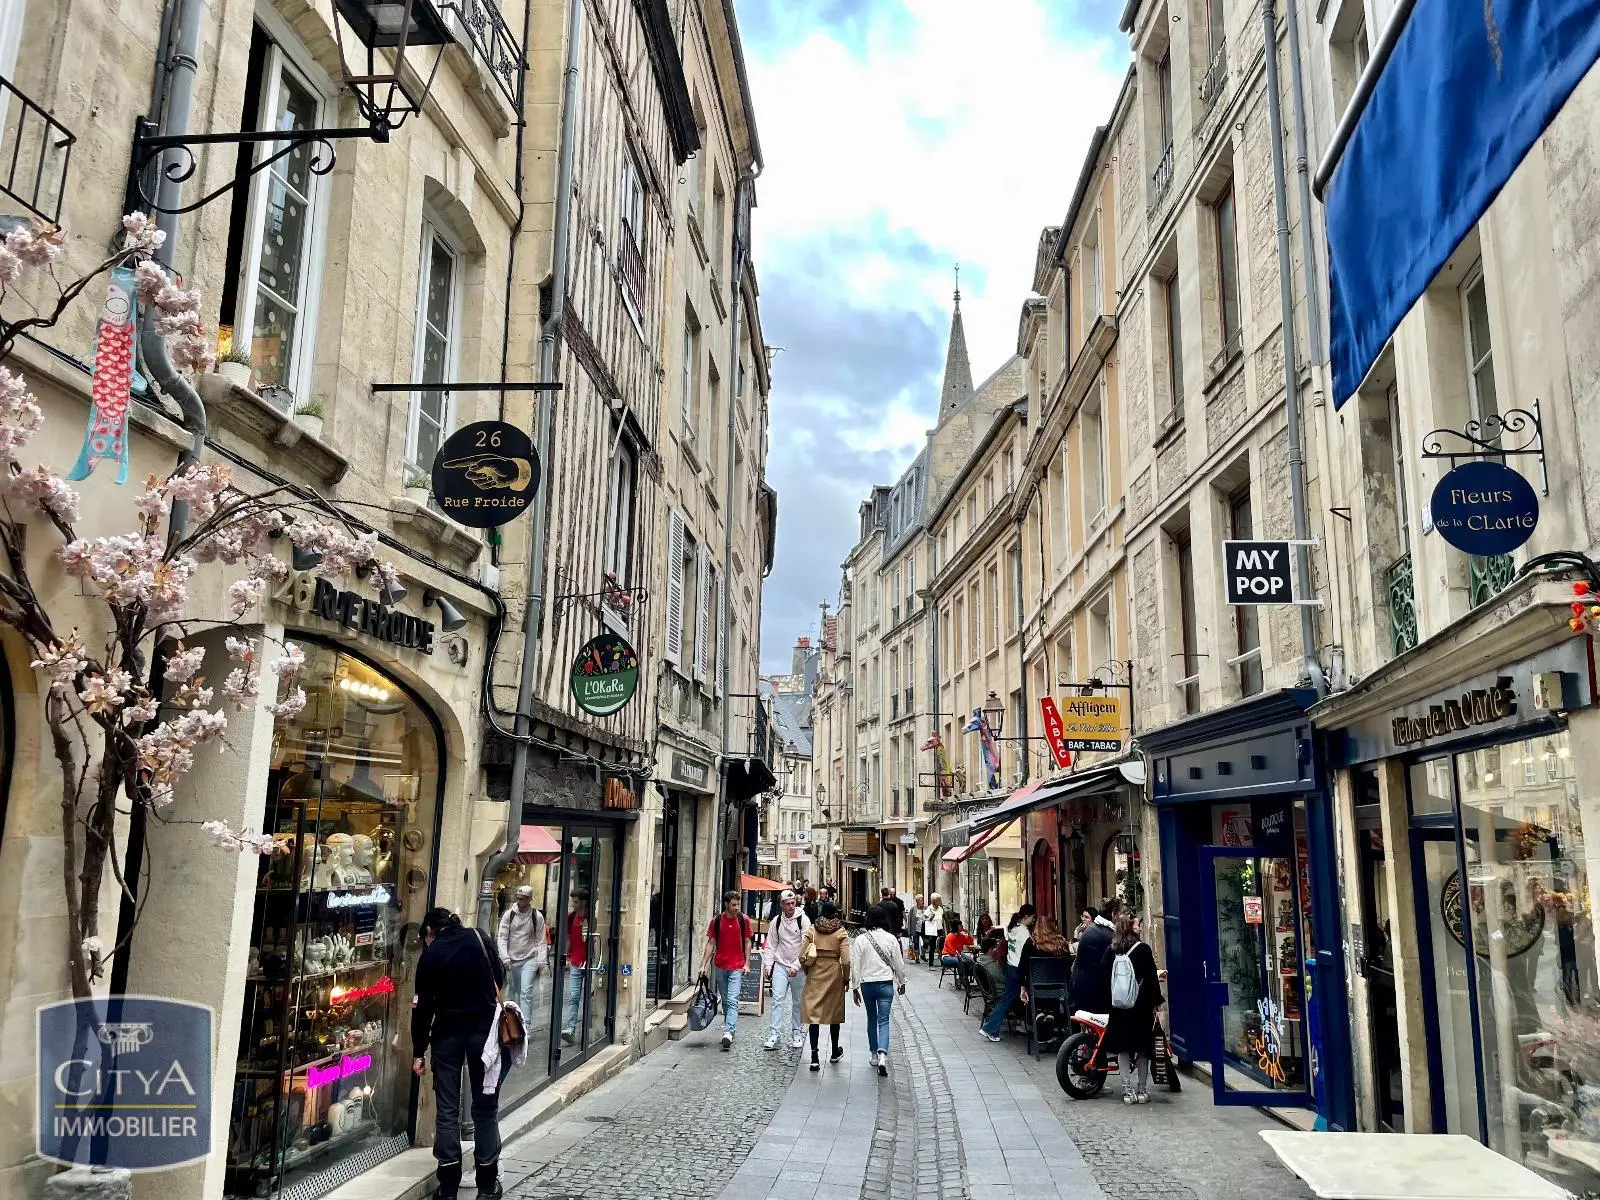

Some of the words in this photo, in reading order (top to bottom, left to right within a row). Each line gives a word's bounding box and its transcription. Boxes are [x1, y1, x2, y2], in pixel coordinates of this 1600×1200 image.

[475, 430, 502, 447] 26
[443, 497, 469, 507] Rue
[474, 496, 525, 507] Froide
[1451, 489, 1512, 505] Fleurs
[1437, 518, 1450, 527] de
[1453, 518, 1463, 527] la
[1235, 550, 1279, 570] MY
[1236, 576, 1284, 595] POP
[313, 577, 362, 631] RUE
[362, 599, 434, 655] FROIDE
[1067, 701, 1116, 717] Affligem
[1425, 707, 1442, 736] de
[1444, 702, 1458, 731] la
[1045, 705, 1067, 759] TABAC
[1068, 742, 1085, 750] BAR
[1091, 742, 1117, 750] TABAC
[1158, 772, 1165, 783] 6
